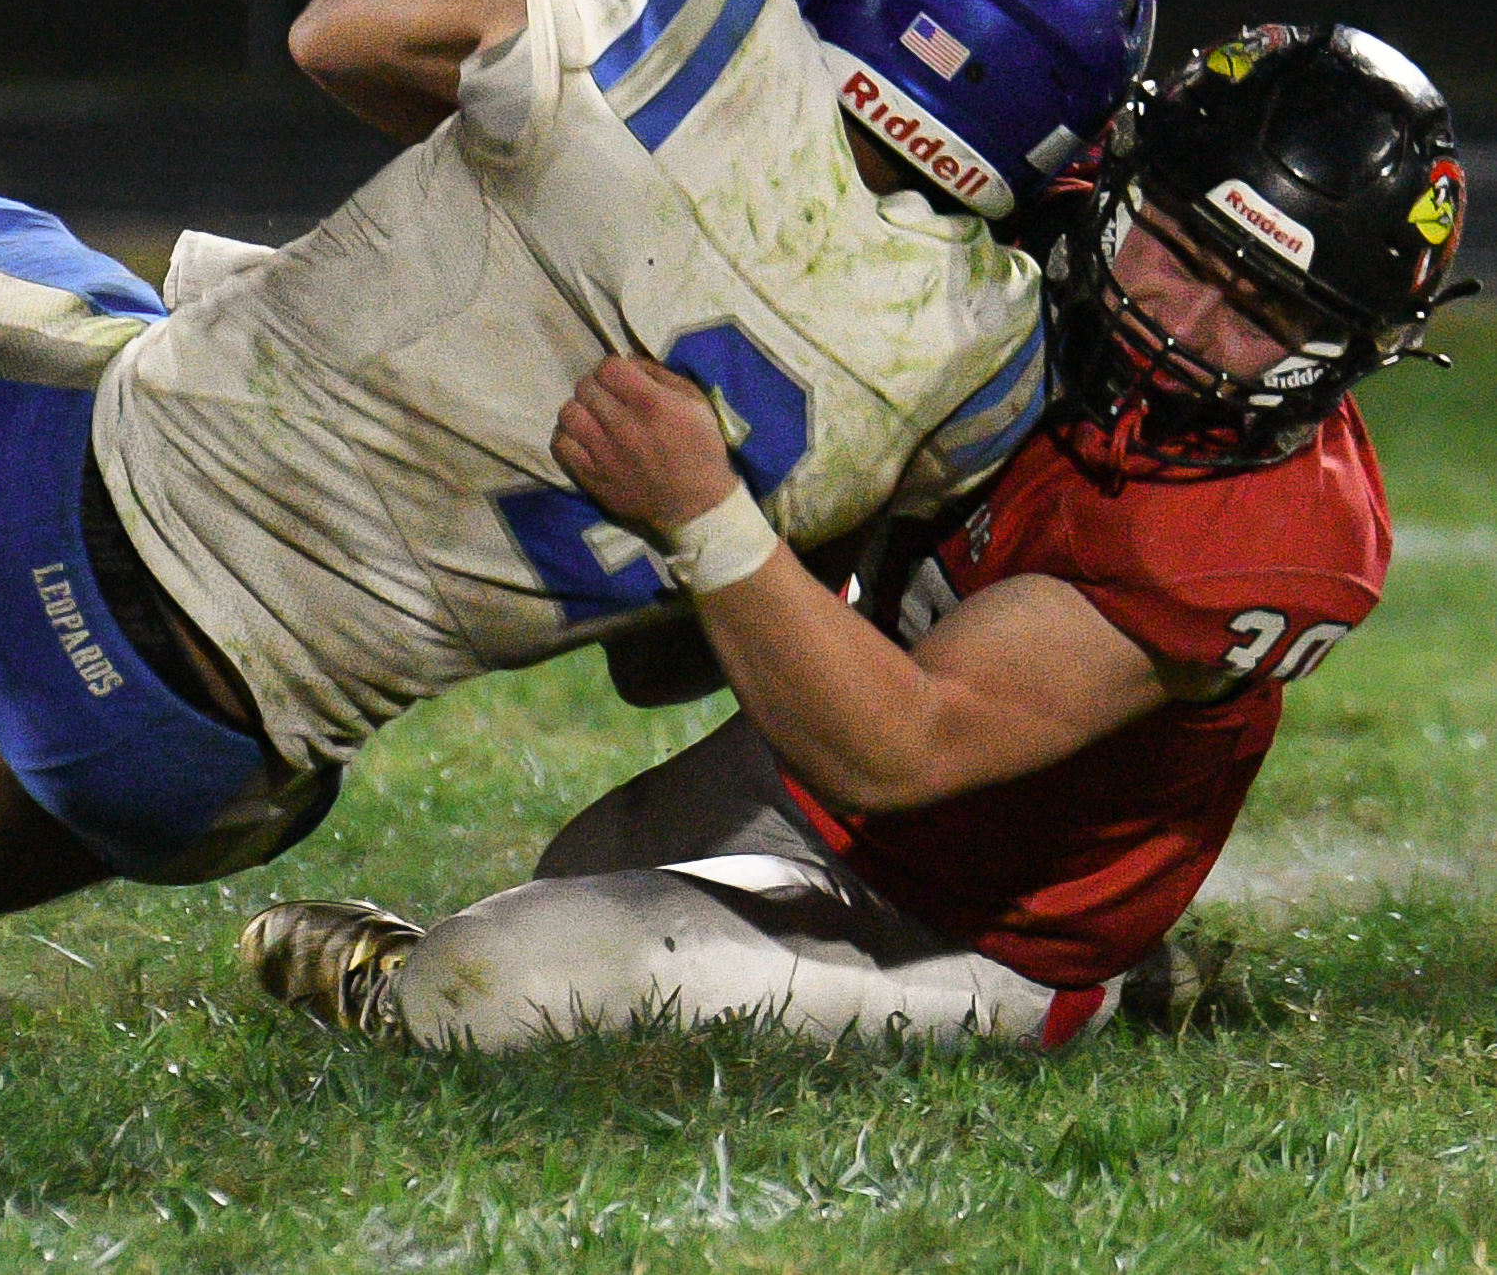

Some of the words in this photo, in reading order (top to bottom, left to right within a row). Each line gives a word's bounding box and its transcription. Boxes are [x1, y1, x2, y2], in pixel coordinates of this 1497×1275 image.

[842, 70, 991, 197] Riddell
[1224, 188, 1304, 254] Riddell
[32, 562, 125, 697] LEOPARDS
